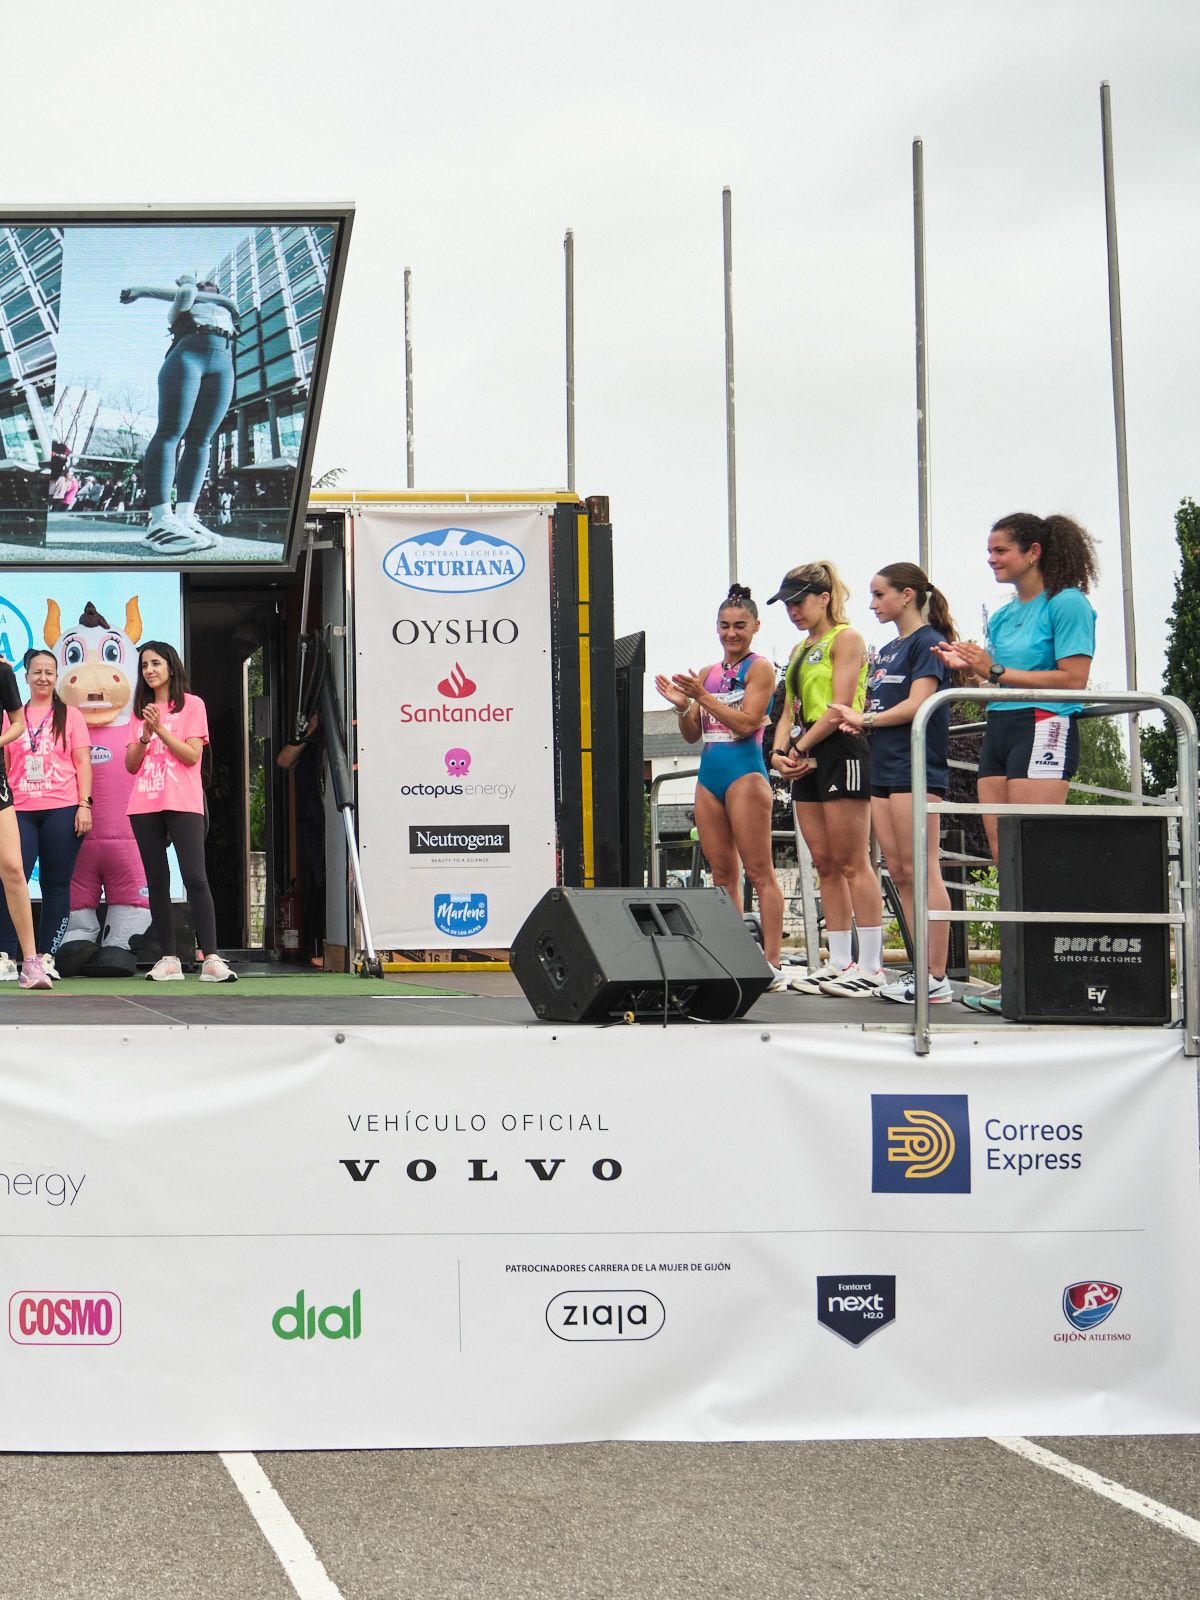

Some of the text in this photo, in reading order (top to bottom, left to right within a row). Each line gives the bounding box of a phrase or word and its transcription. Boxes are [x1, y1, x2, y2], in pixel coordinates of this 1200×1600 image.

[394, 552, 516, 576] ASTURIANA
[392, 619, 519, 645] OYSHO
[400, 703, 513, 723] Santander
[400, 783, 516, 800] octopus energy
[416, 831, 503, 850] Neutrogena
[437, 902, 485, 926] Marlene
[51, 917, 69, 954] adidas
[1054, 935, 1142, 953] portos
[347, 1110, 610, 1132] VEHÍCULO OFICIAL
[984, 1118, 1083, 1142] Correos
[339, 1158, 623, 1182] VOLVO
[987, 1148, 1082, 1176] Express
[505, 1264, 586, 1273] PATROCINADORES
[588, 1264, 629, 1272] CARRERA
[691, 1263, 702, 1271] DE
[705, 1262, 731, 1271] GIJÓN
[272, 1287, 361, 1340] dial
[828, 1293, 884, 1312] next
[19, 1298, 113, 1337] COSMO
[1053, 1331, 1131, 1343] GIJÓN ATLETISMO
